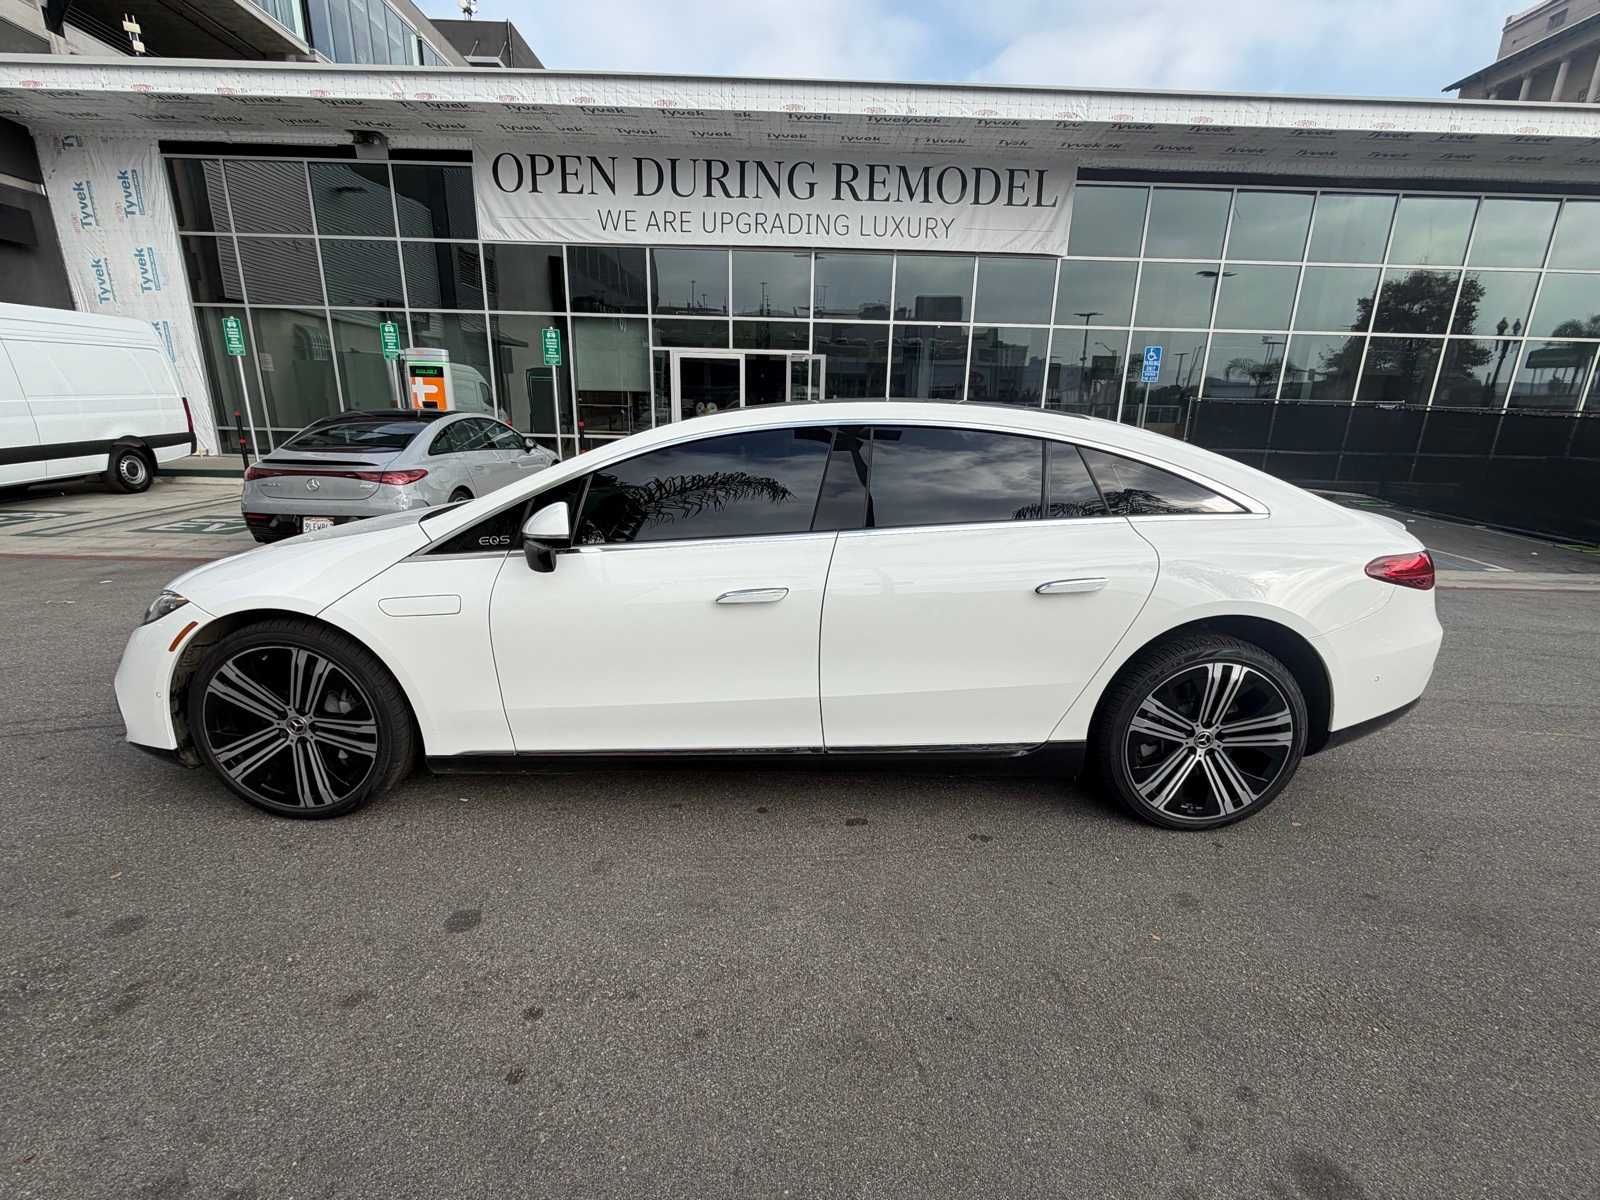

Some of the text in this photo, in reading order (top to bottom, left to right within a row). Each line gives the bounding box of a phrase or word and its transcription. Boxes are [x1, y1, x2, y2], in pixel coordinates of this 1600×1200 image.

[657, 109, 705, 117] Tyvek
[788, 113, 832, 121] Tyvek
[976, 119, 1021, 127] Tyvek
[690, 130, 732, 138] Tyvek
[117, 169, 137, 218] Tyvek
[492, 152, 1058, 208] OPEN DURING REMODEL
[73, 181, 93, 229] Tyvek
[597, 209, 955, 239] WE ARE UPGRADING LUXURY
[91, 259, 111, 304] Tyvek
[134, 248, 153, 293] Tyvek
[478, 535, 510, 546] EQS
